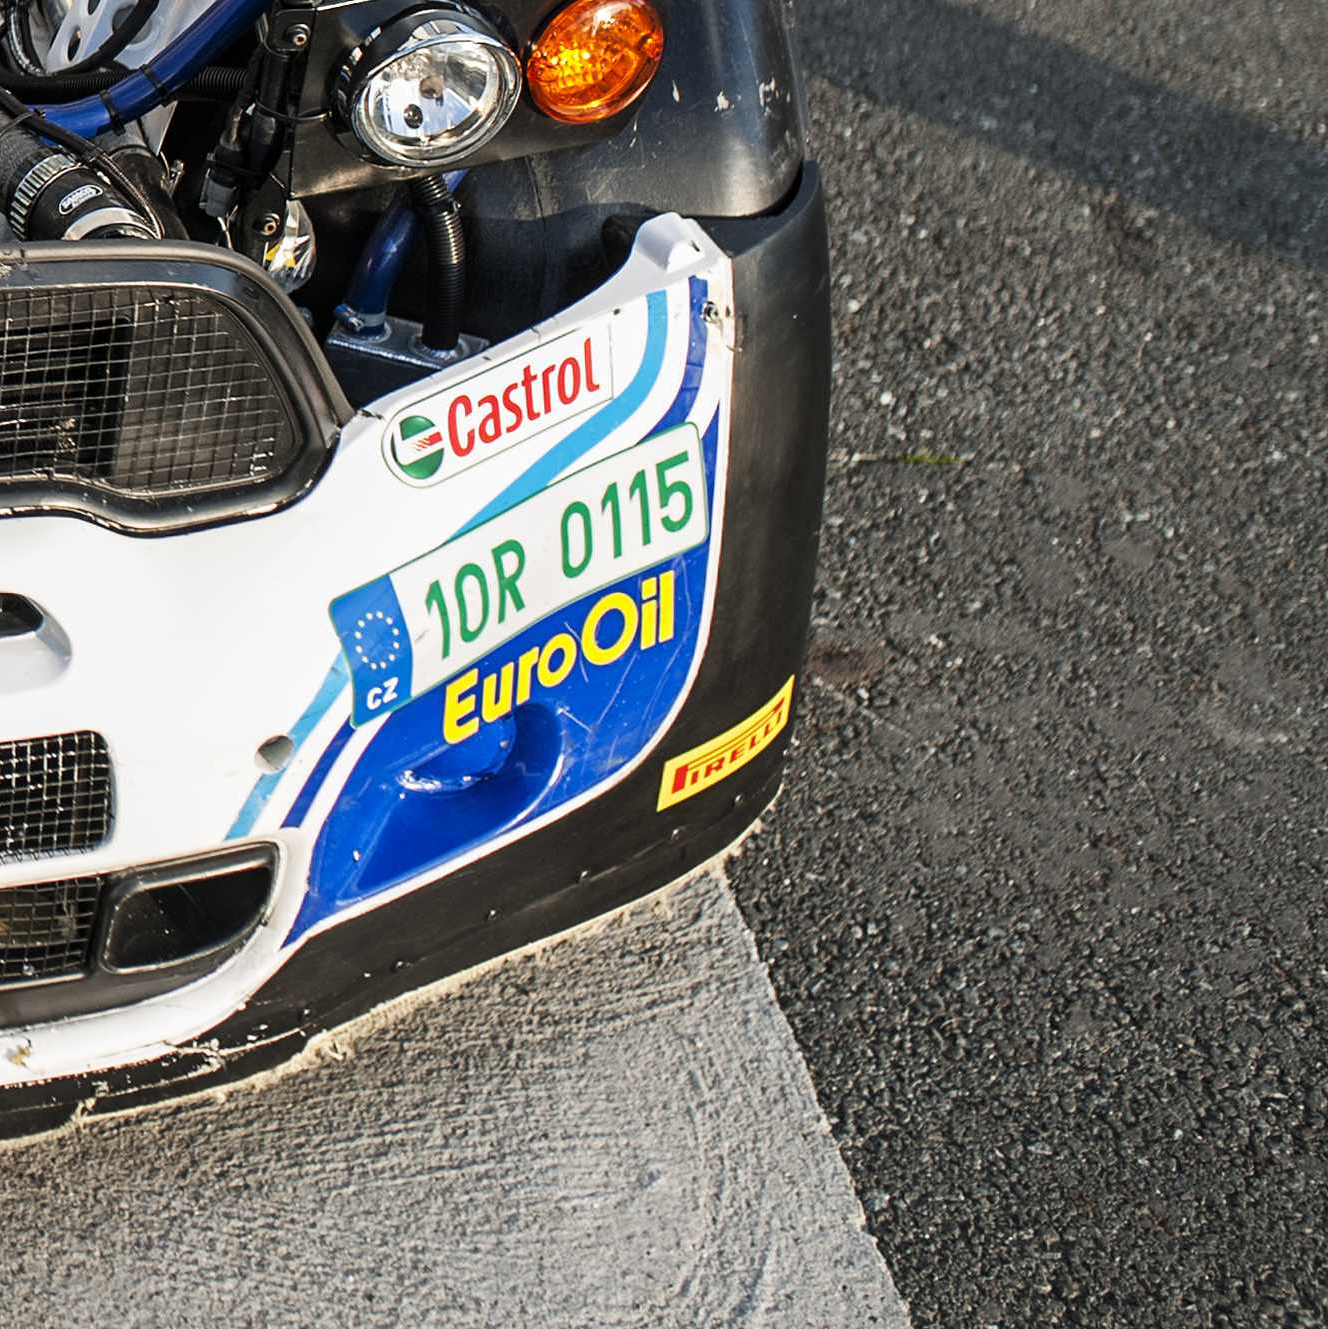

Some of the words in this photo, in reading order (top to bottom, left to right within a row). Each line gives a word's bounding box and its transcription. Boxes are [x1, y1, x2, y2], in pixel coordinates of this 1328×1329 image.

[447, 337, 601, 459] Castrol
[425, 539, 527, 661] 10R
[560, 451, 694, 580] 0115
[366, 680, 399, 710] CZ
[443, 571, 674, 743] EuroOil
[671, 697, 785, 795] PIRELLI
